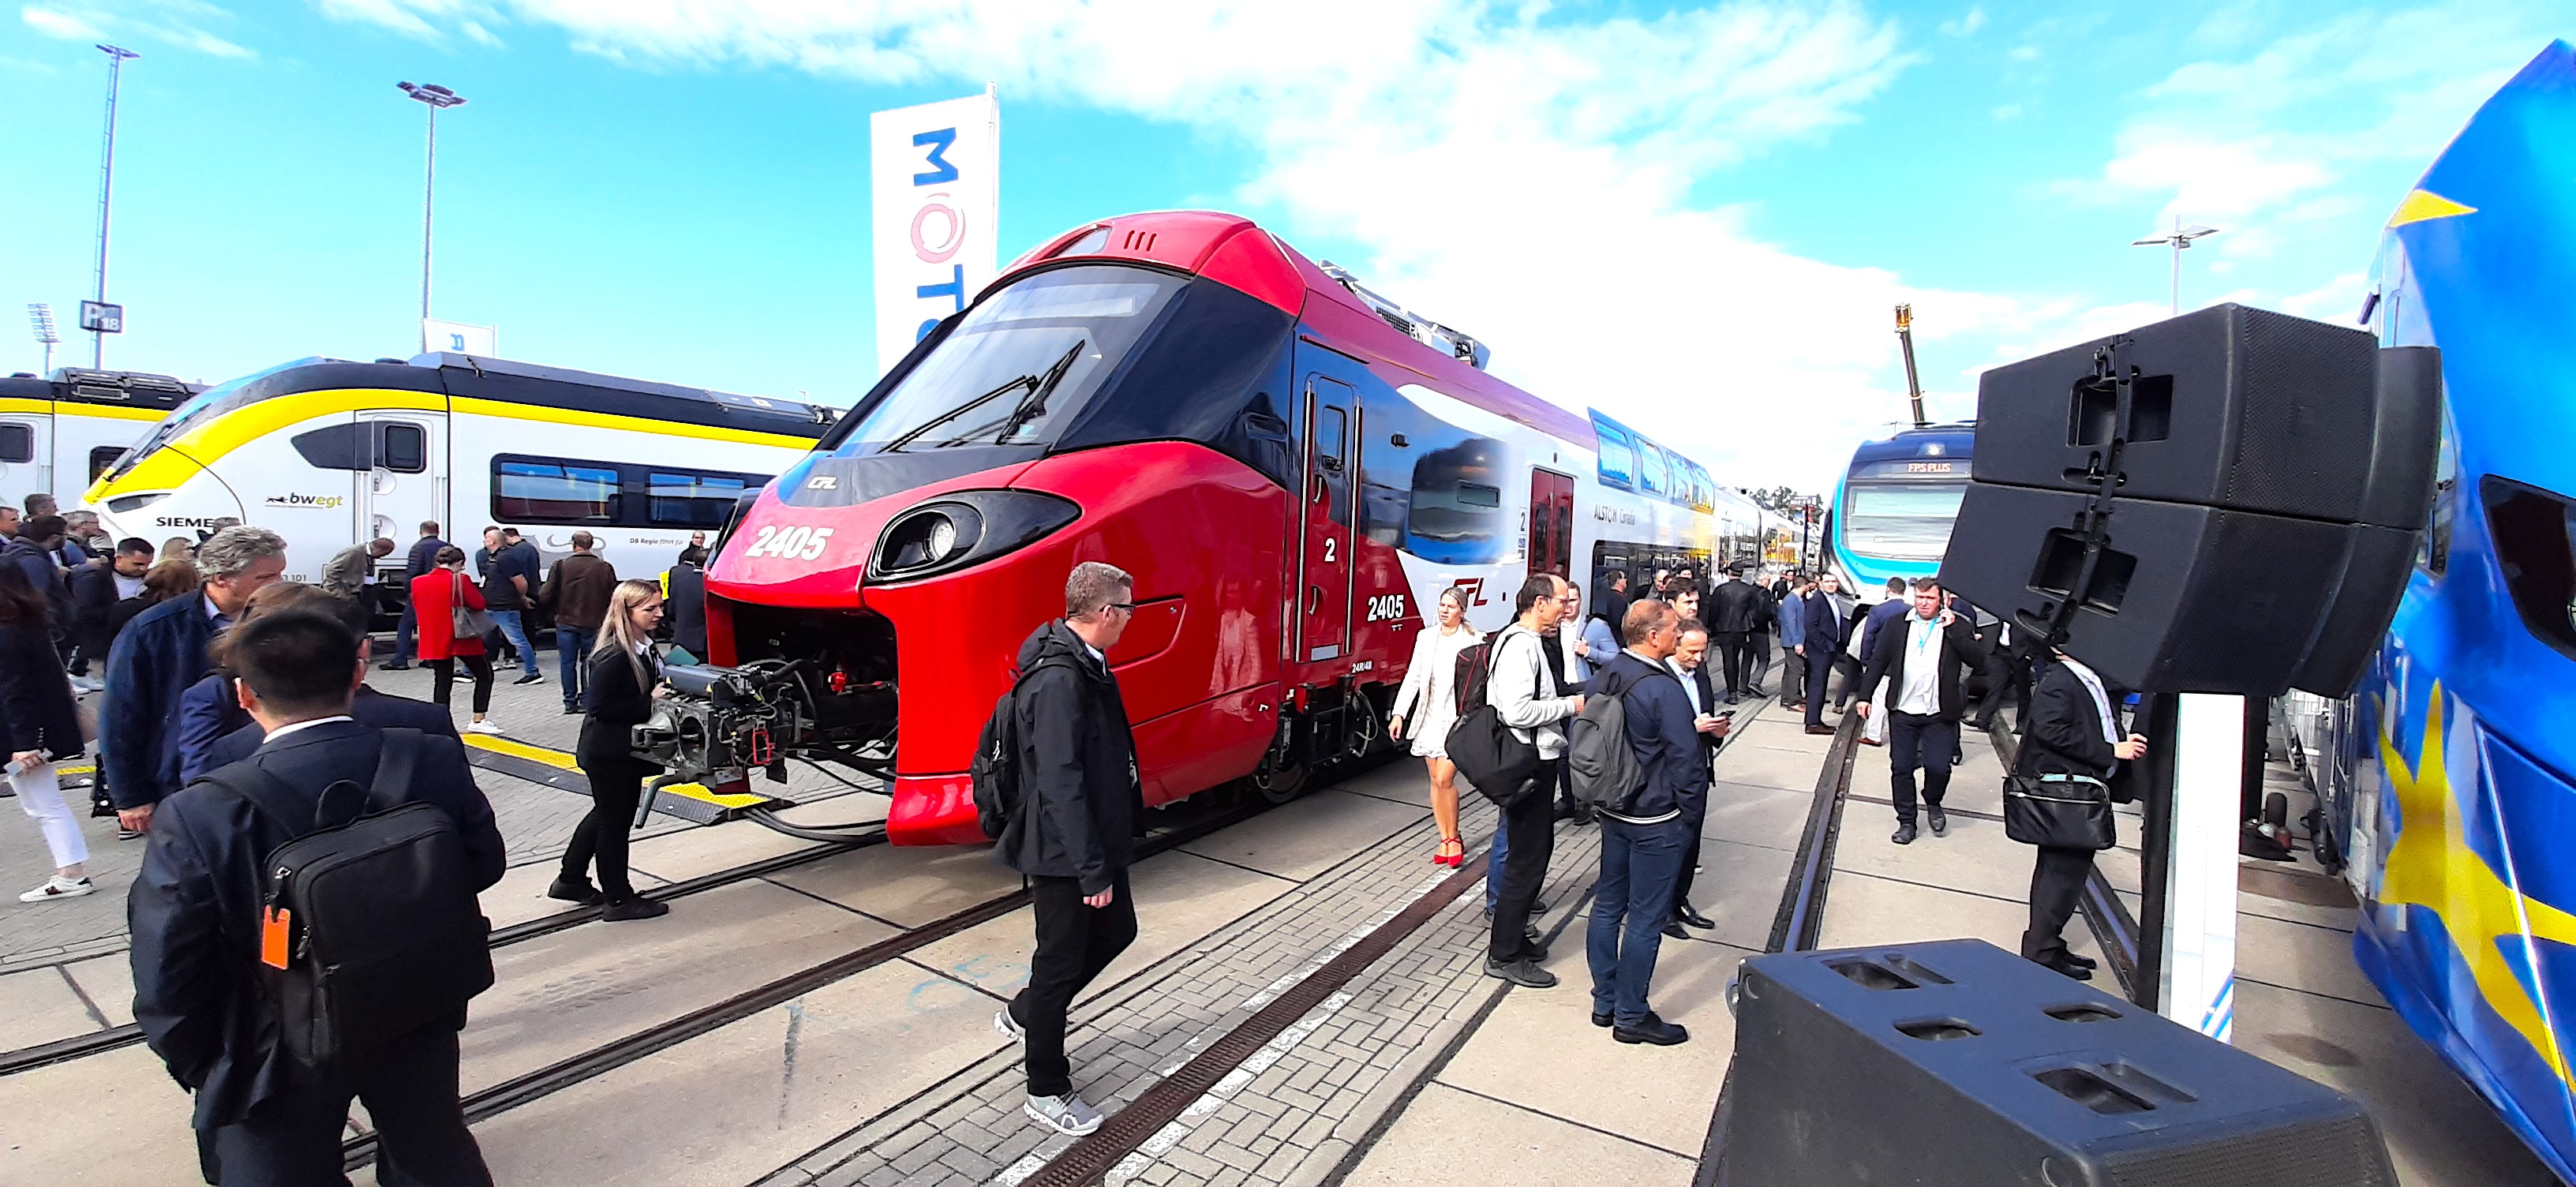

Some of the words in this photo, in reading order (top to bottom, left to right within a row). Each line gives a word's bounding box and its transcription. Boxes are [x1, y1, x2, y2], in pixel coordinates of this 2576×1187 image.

[102, 317, 120, 331] 18
[1908, 462, 1926, 473] FPS
[1927, 462, 1952, 473] PLUS
[290, 492, 343, 508] bwegt
[1520, 511, 1526, 531] 2
[745, 525, 836, 561] 2405
[1324, 537, 1335, 562] 2
[1367, 594, 1405, 622] 2405
